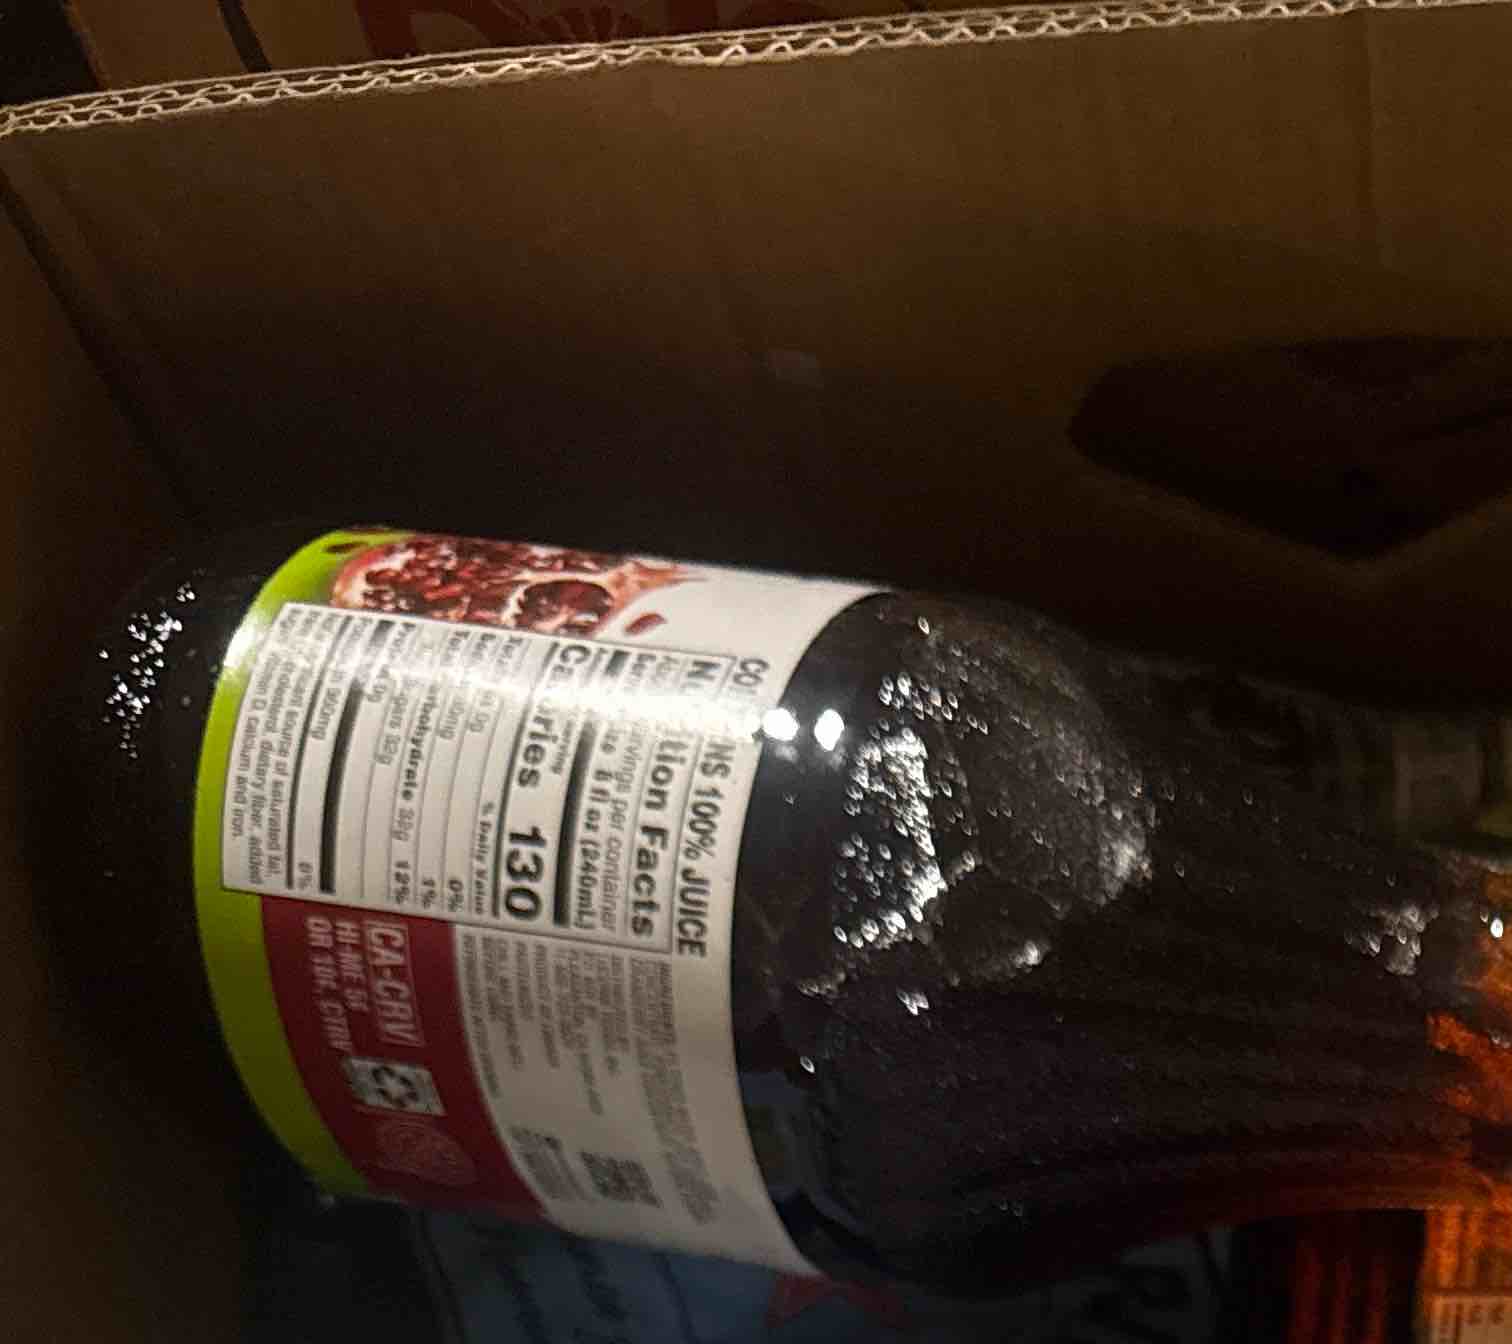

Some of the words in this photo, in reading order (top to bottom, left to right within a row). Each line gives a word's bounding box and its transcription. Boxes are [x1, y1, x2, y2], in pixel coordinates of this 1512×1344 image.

[681, 786, 724, 860] 100%
[504, 825, 547, 921] 130
[631, 824, 670, 937] Facts
[677, 866, 711, 956] JUICE
